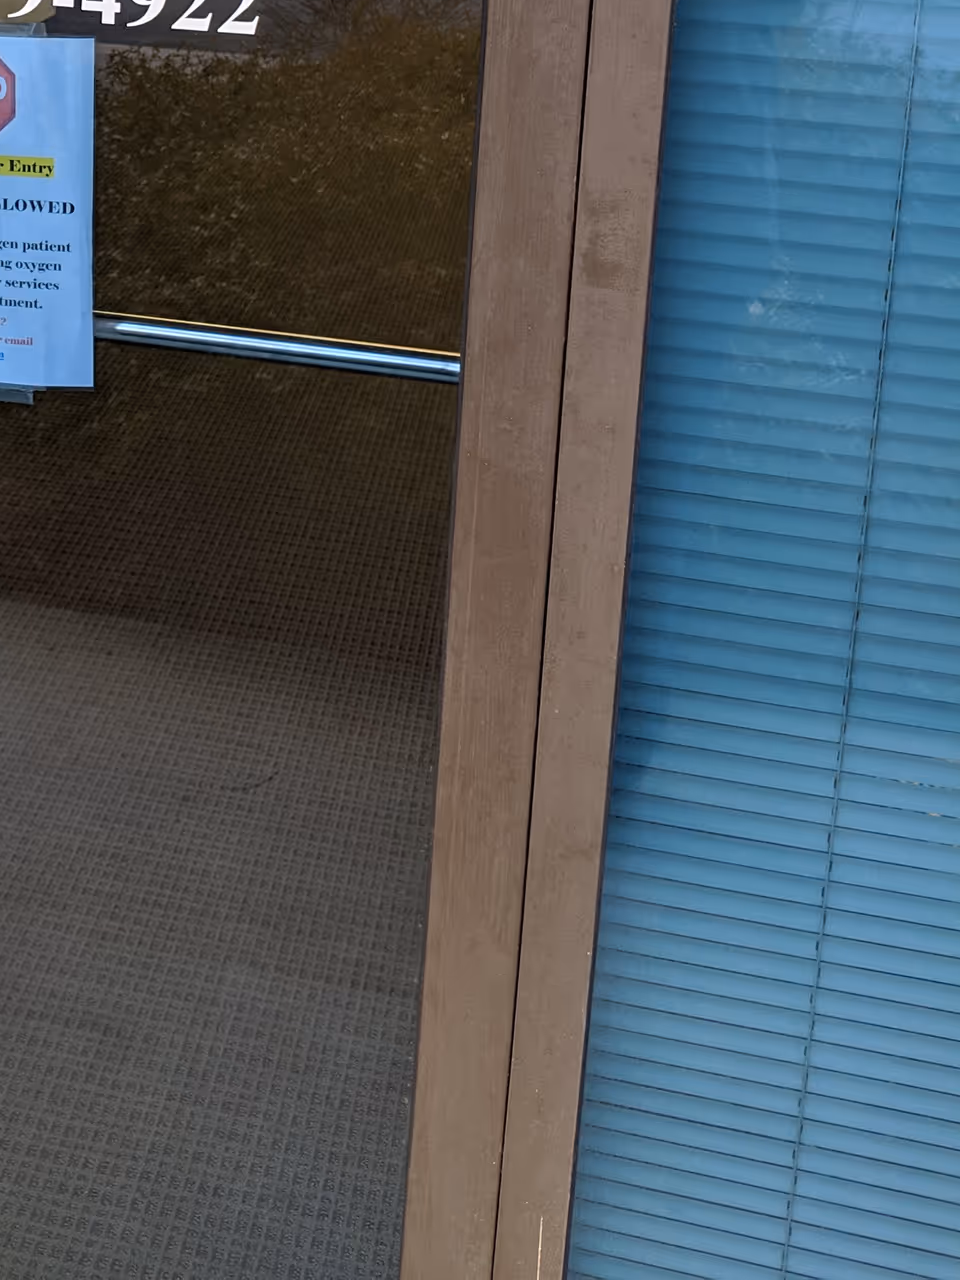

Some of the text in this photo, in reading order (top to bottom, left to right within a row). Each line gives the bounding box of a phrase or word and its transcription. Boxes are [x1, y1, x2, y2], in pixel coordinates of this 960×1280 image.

[9, 159, 54, 177] Entry
[22, 239, 72, 254] patient
[15, 260, 62, 273] oxygen
[4, 278, 60, 291] services
[4, 335, 34, 347] email
